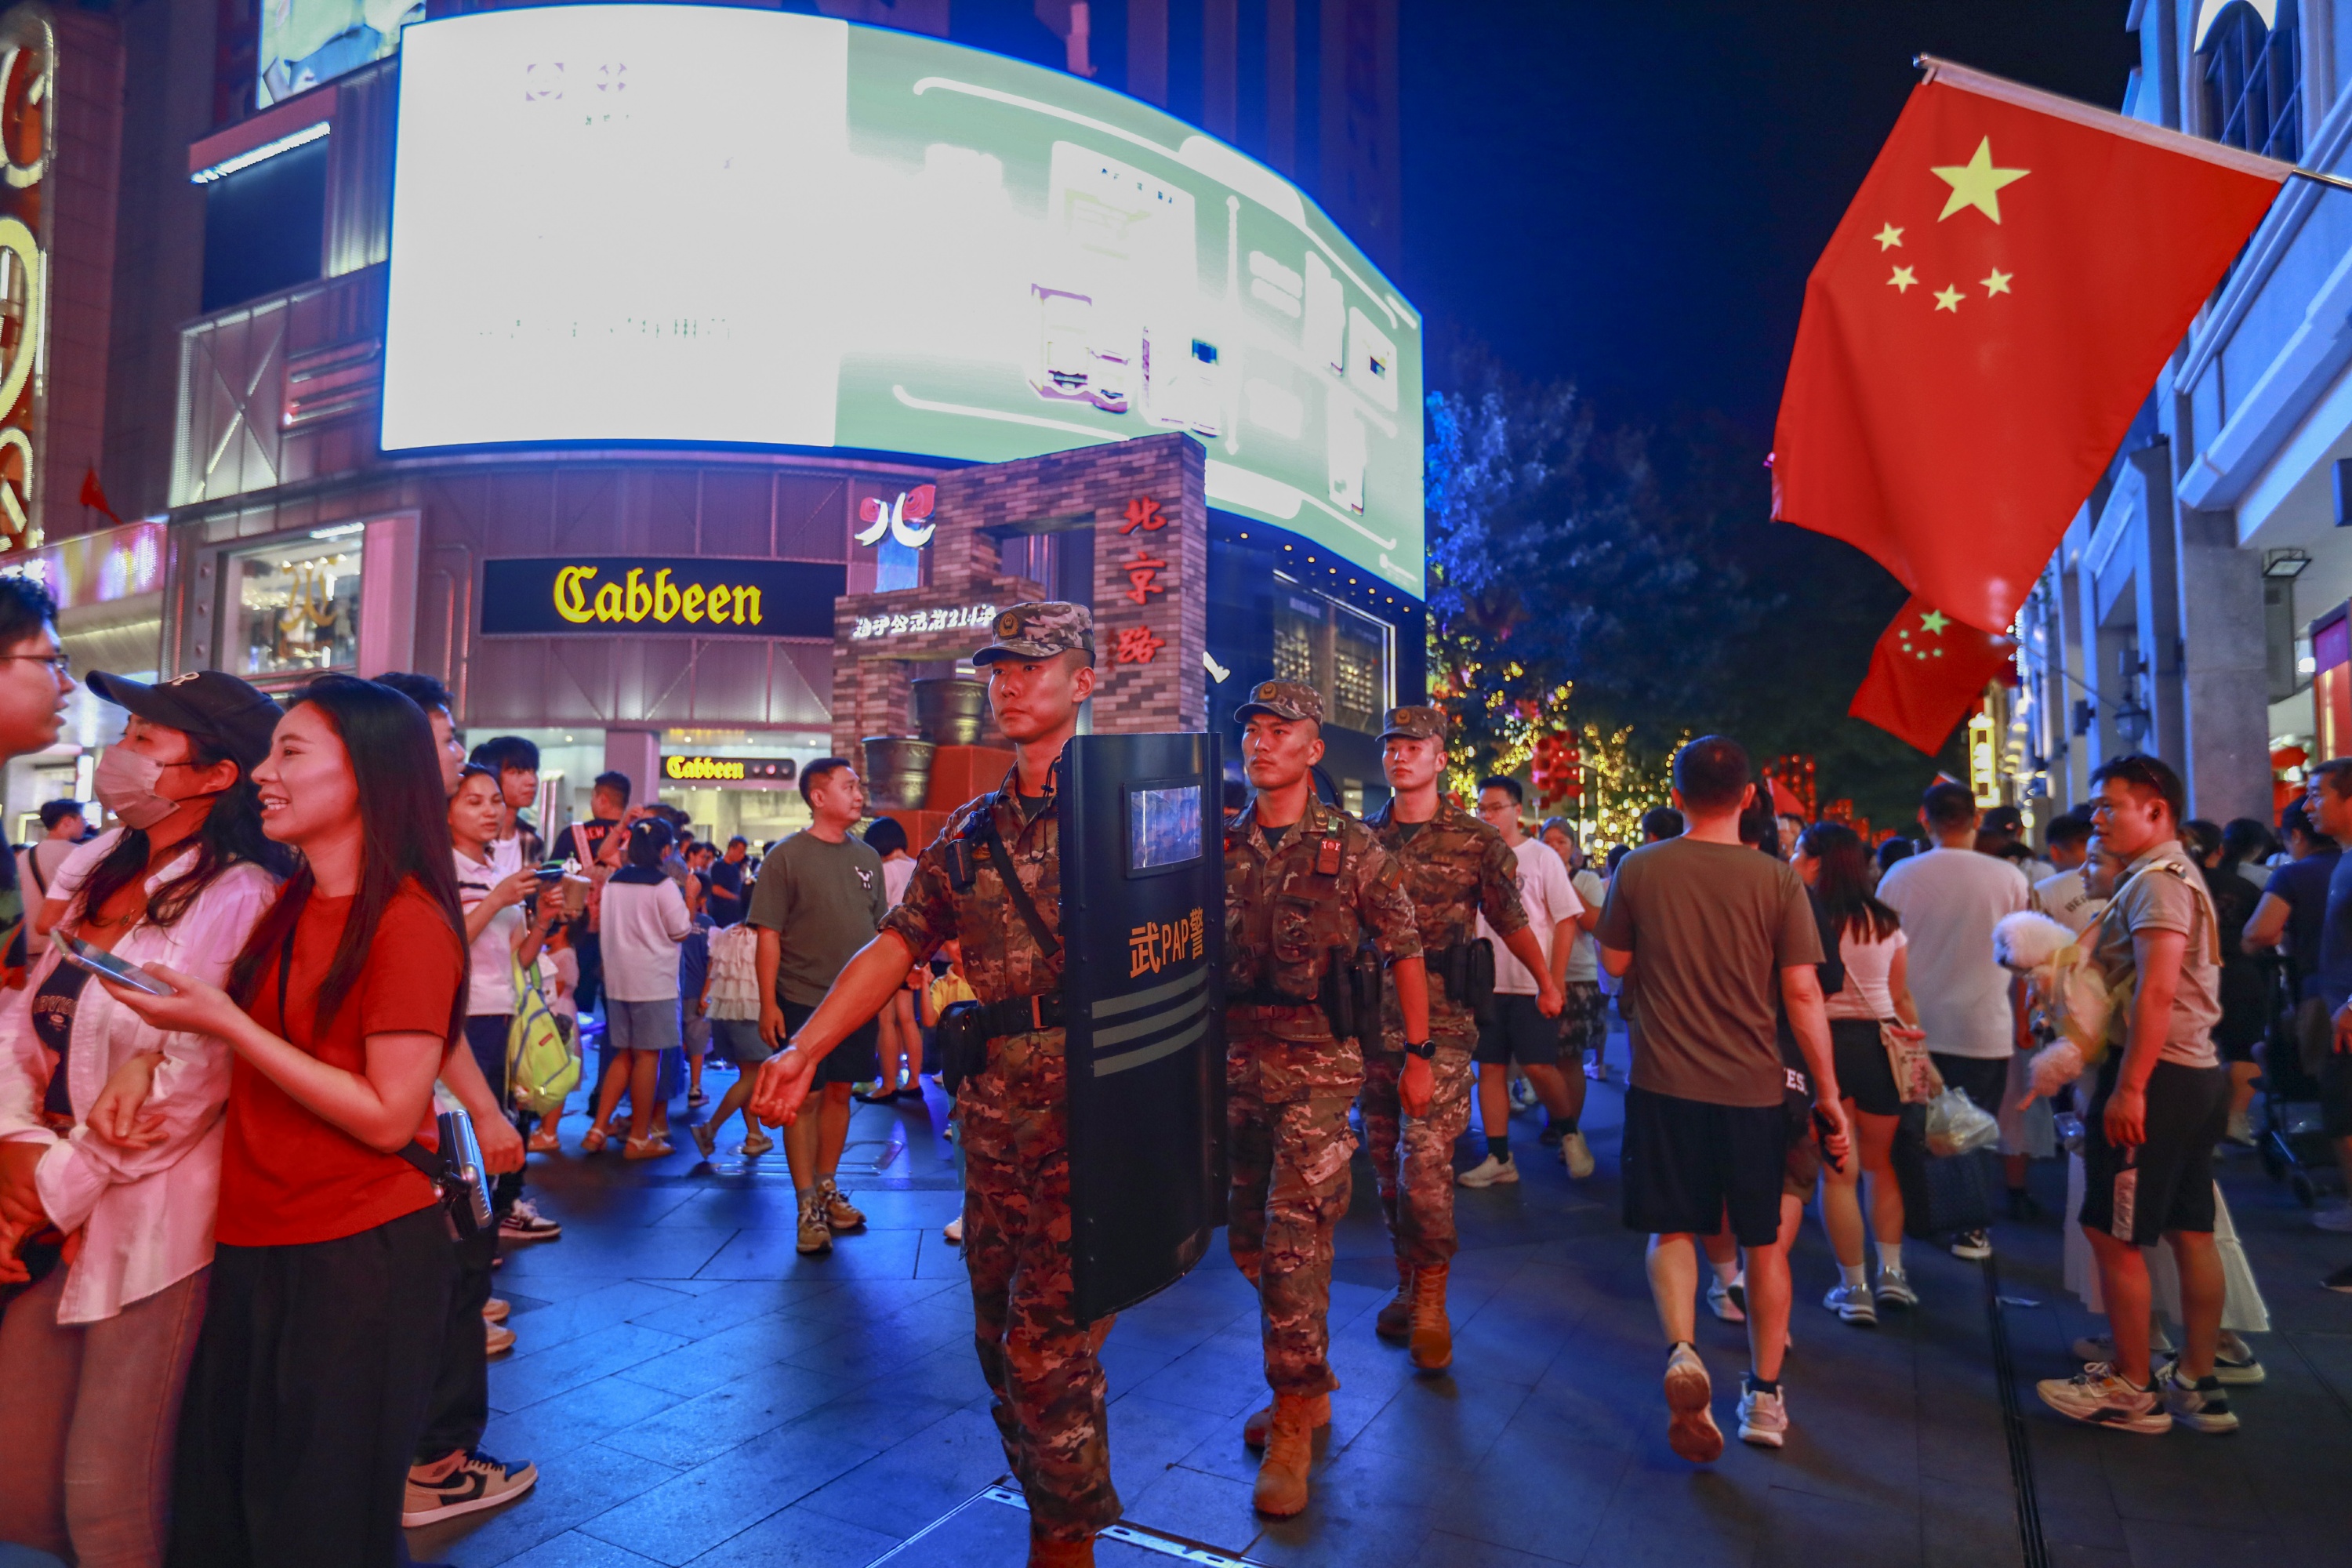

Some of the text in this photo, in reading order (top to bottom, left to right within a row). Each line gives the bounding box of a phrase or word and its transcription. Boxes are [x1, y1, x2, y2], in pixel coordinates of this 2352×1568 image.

[553, 565, 763, 625] Cabbeen
[1118, 495, 1167, 665] 北京路
[666, 755, 745, 779] Cabbeen
[1129, 906, 1203, 978] 武PAP警
